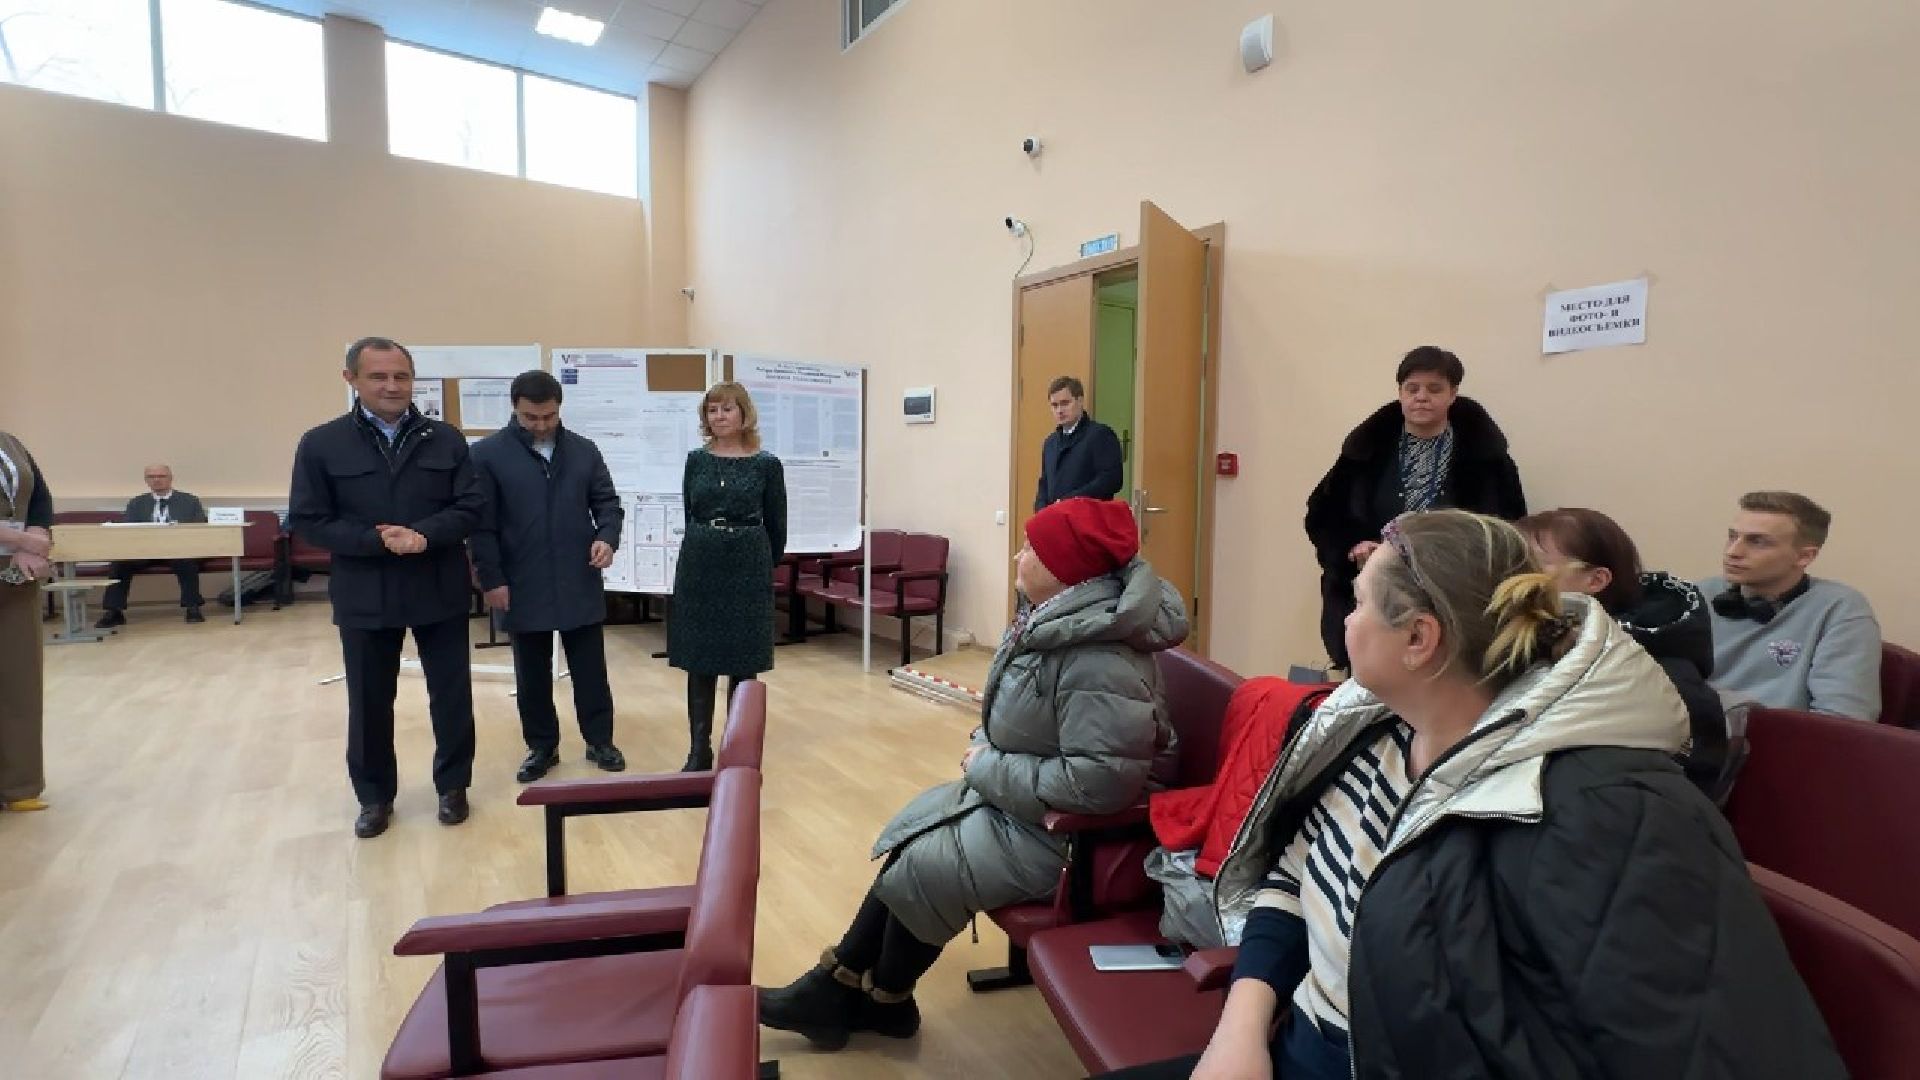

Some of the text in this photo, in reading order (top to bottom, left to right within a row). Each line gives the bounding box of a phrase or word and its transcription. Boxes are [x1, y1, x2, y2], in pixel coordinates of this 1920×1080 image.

[1561, 295, 1630, 311] МЕСТО ДЛЯ
[1570, 309, 1618, 322] ФОТО- И
[1549, 318, 1640, 337] ВИДЕОСЪЕМКИ
